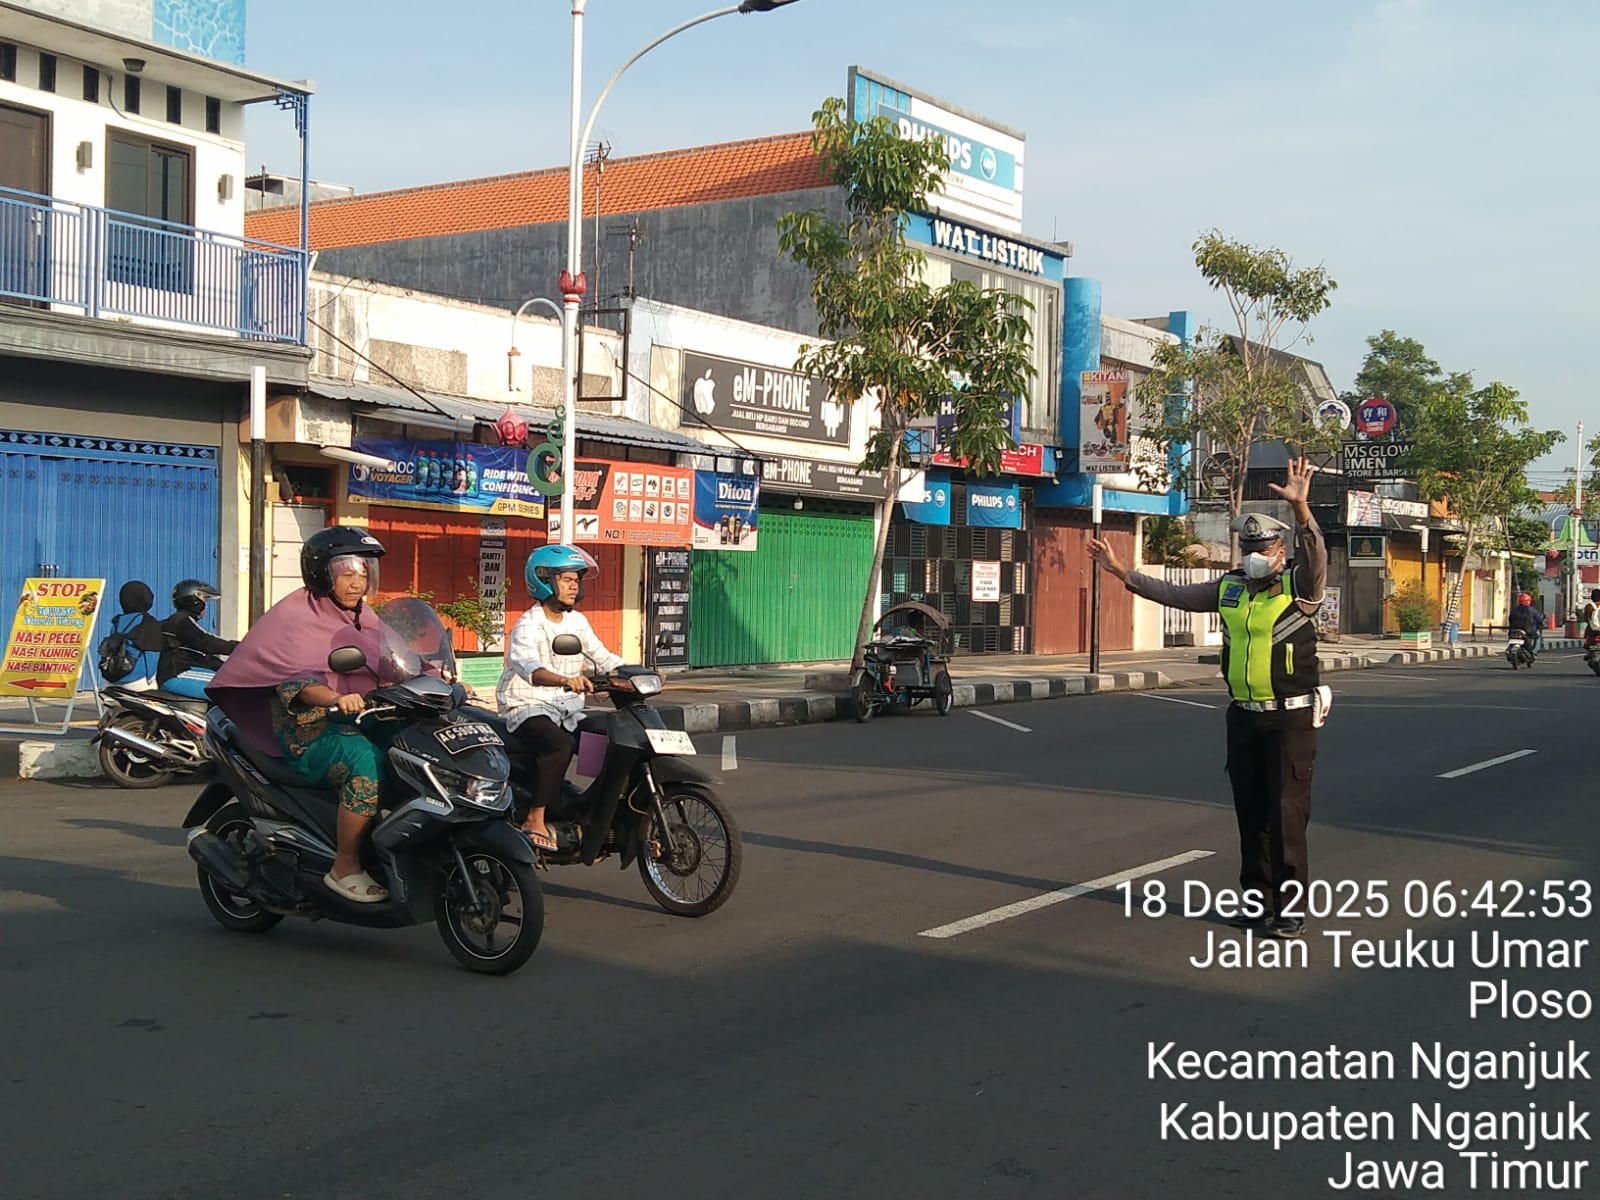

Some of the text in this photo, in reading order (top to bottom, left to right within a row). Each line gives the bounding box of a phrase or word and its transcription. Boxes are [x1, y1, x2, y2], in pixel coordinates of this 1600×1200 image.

[982, 233, 1044, 274] LISTRIK
[733, 367, 811, 413] eM-PHONE
[1344, 445, 1367, 458] MS
[1351, 457, 1387, 470] MEN
[370, 472, 413, 484] VOYAGER
[483, 468, 506, 479] RIDE
[763, 459, 812, 484] eM-PHONE
[1348, 469, 1372, 477] STORE
[718, 482, 751, 501] Diton
[971, 493, 1003, 508] PHILIPS
[484, 562, 500, 572] BAN
[36, 583, 88, 597] STOP
[15, 631, 82, 644] NASI PECEL
[11, 645, 79, 658] NASI KUNING
[7, 661, 76, 673] NASI BANTING
